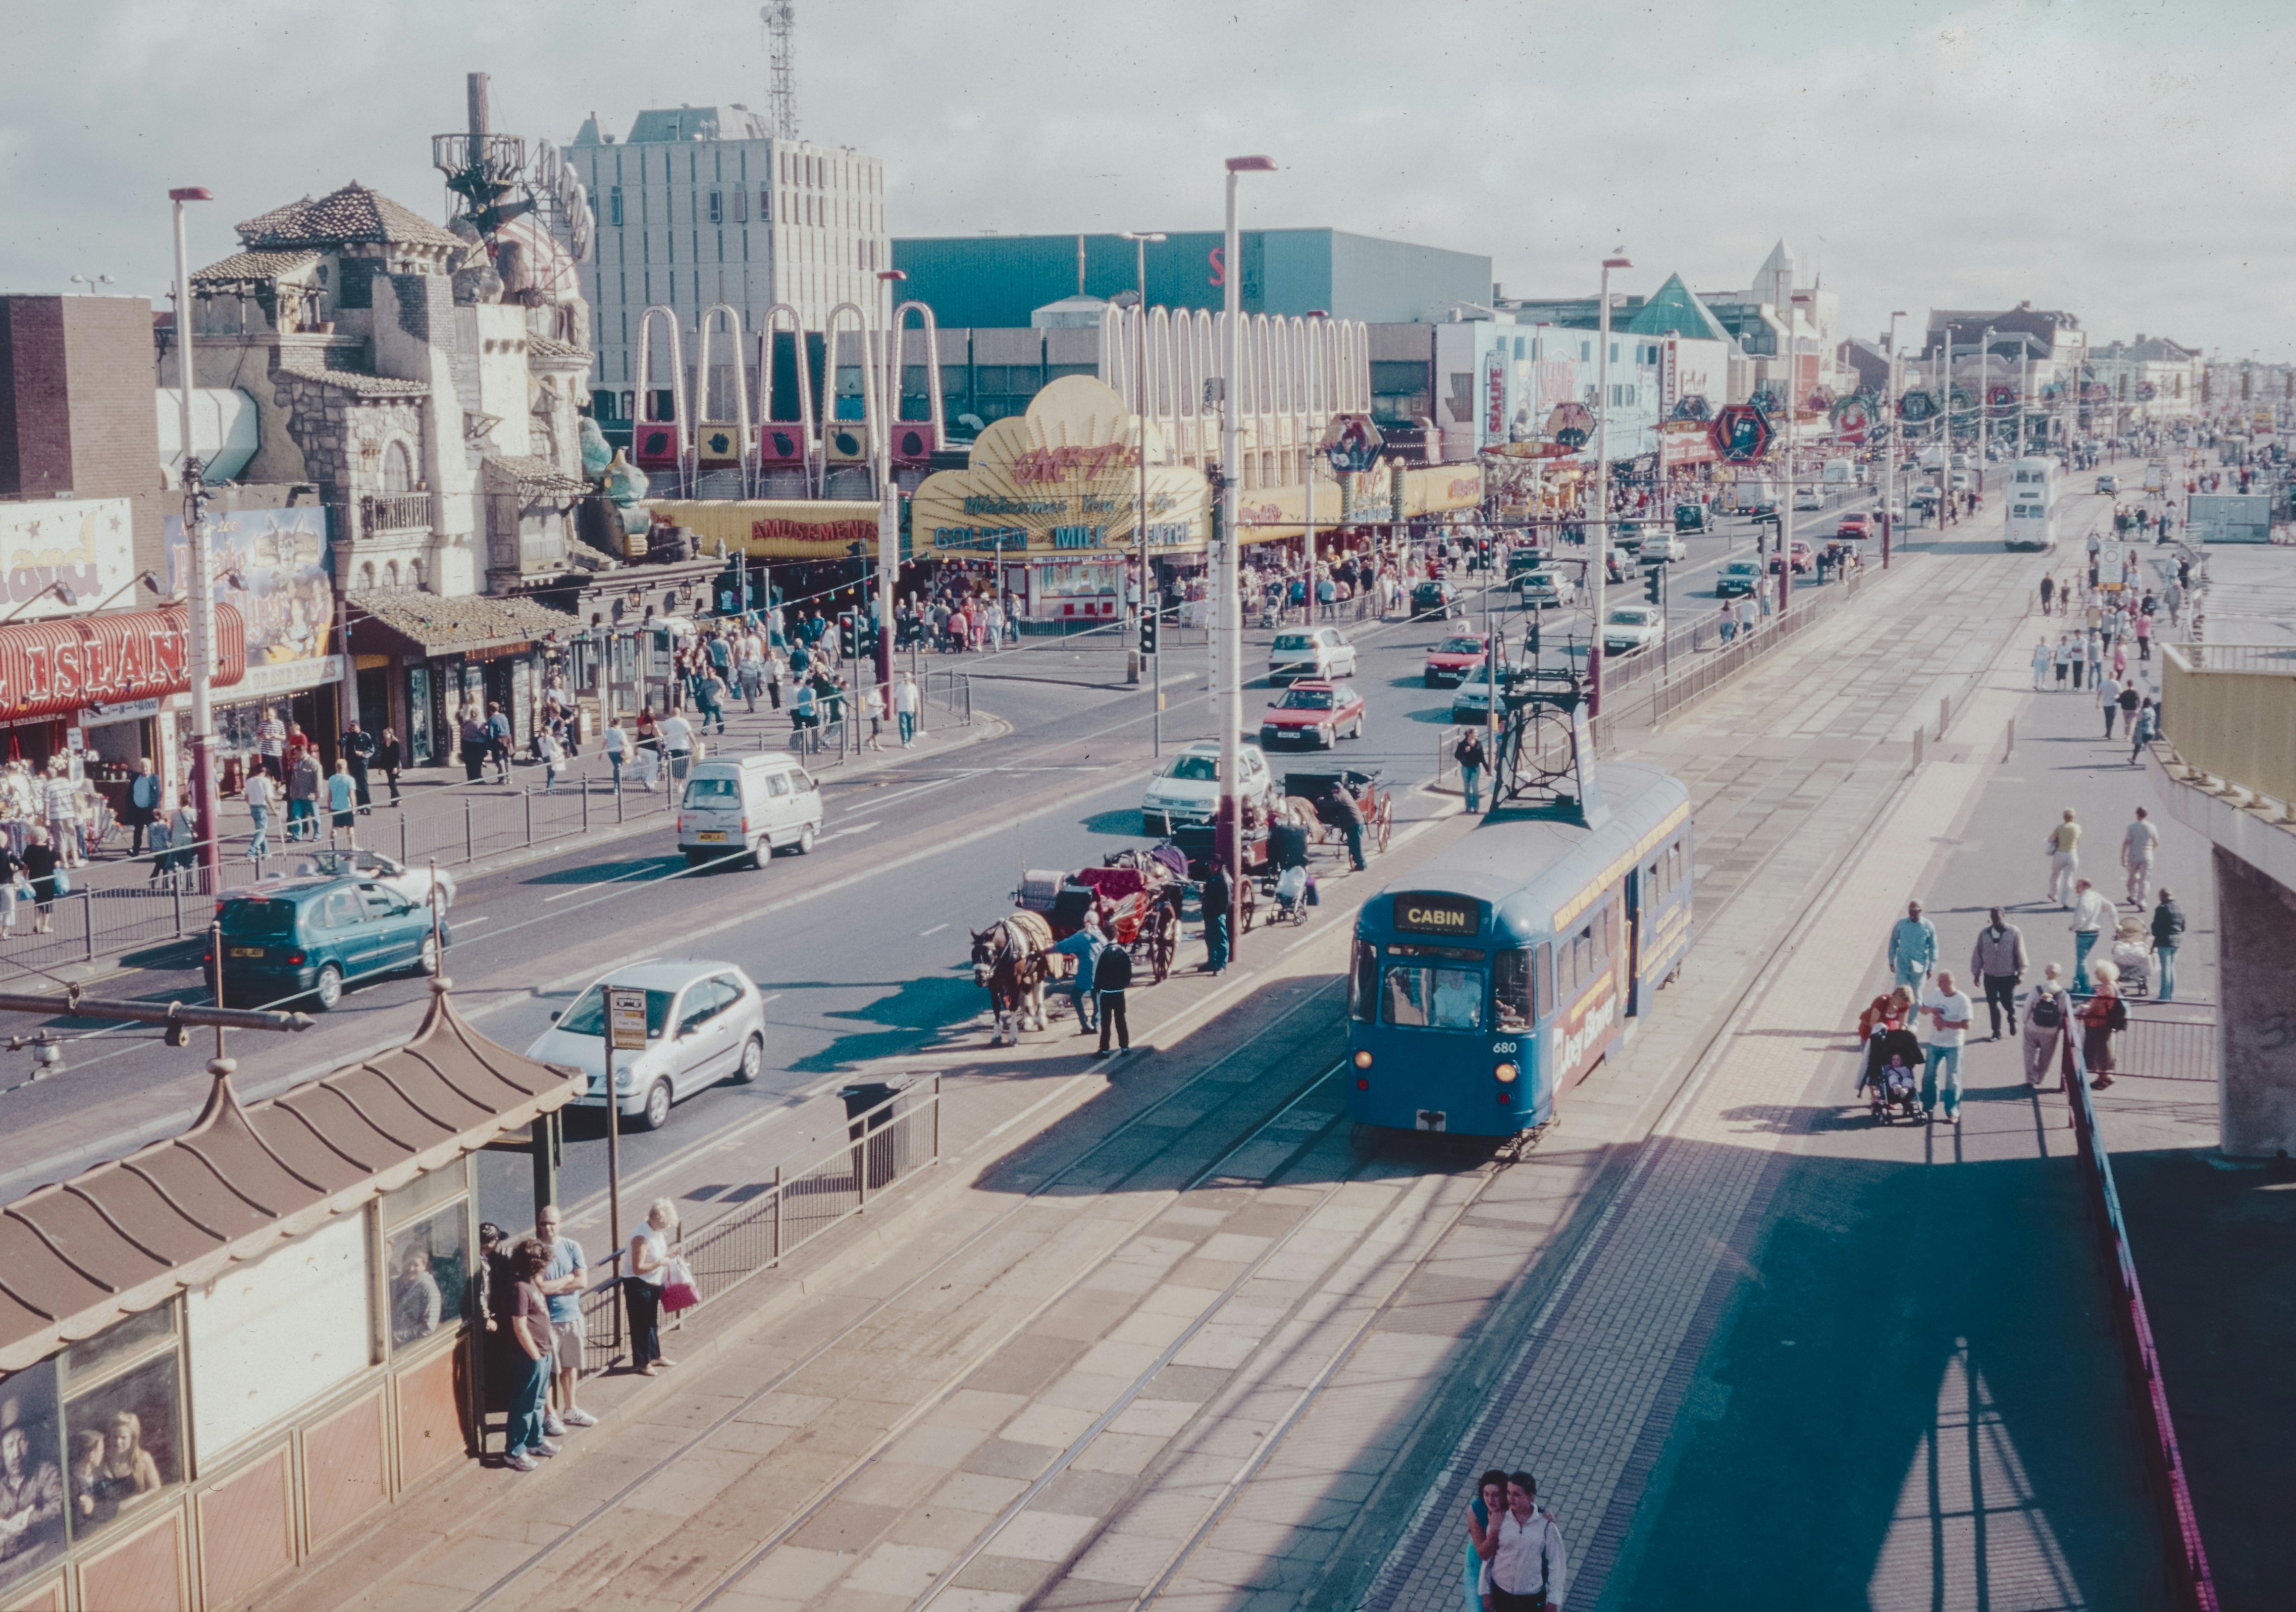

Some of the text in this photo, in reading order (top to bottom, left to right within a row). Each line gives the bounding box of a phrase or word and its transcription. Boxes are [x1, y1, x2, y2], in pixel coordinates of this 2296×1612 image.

[1082, 493, 1114, 513] You
[752, 518, 879, 542] AMUSEMENTS
[934, 526, 1028, 551] GOLDEN
[1055, 525, 1108, 549] MILE
[1408, 908, 1465, 926] CABIN
[1493, 1042, 1517, 1053] 680
